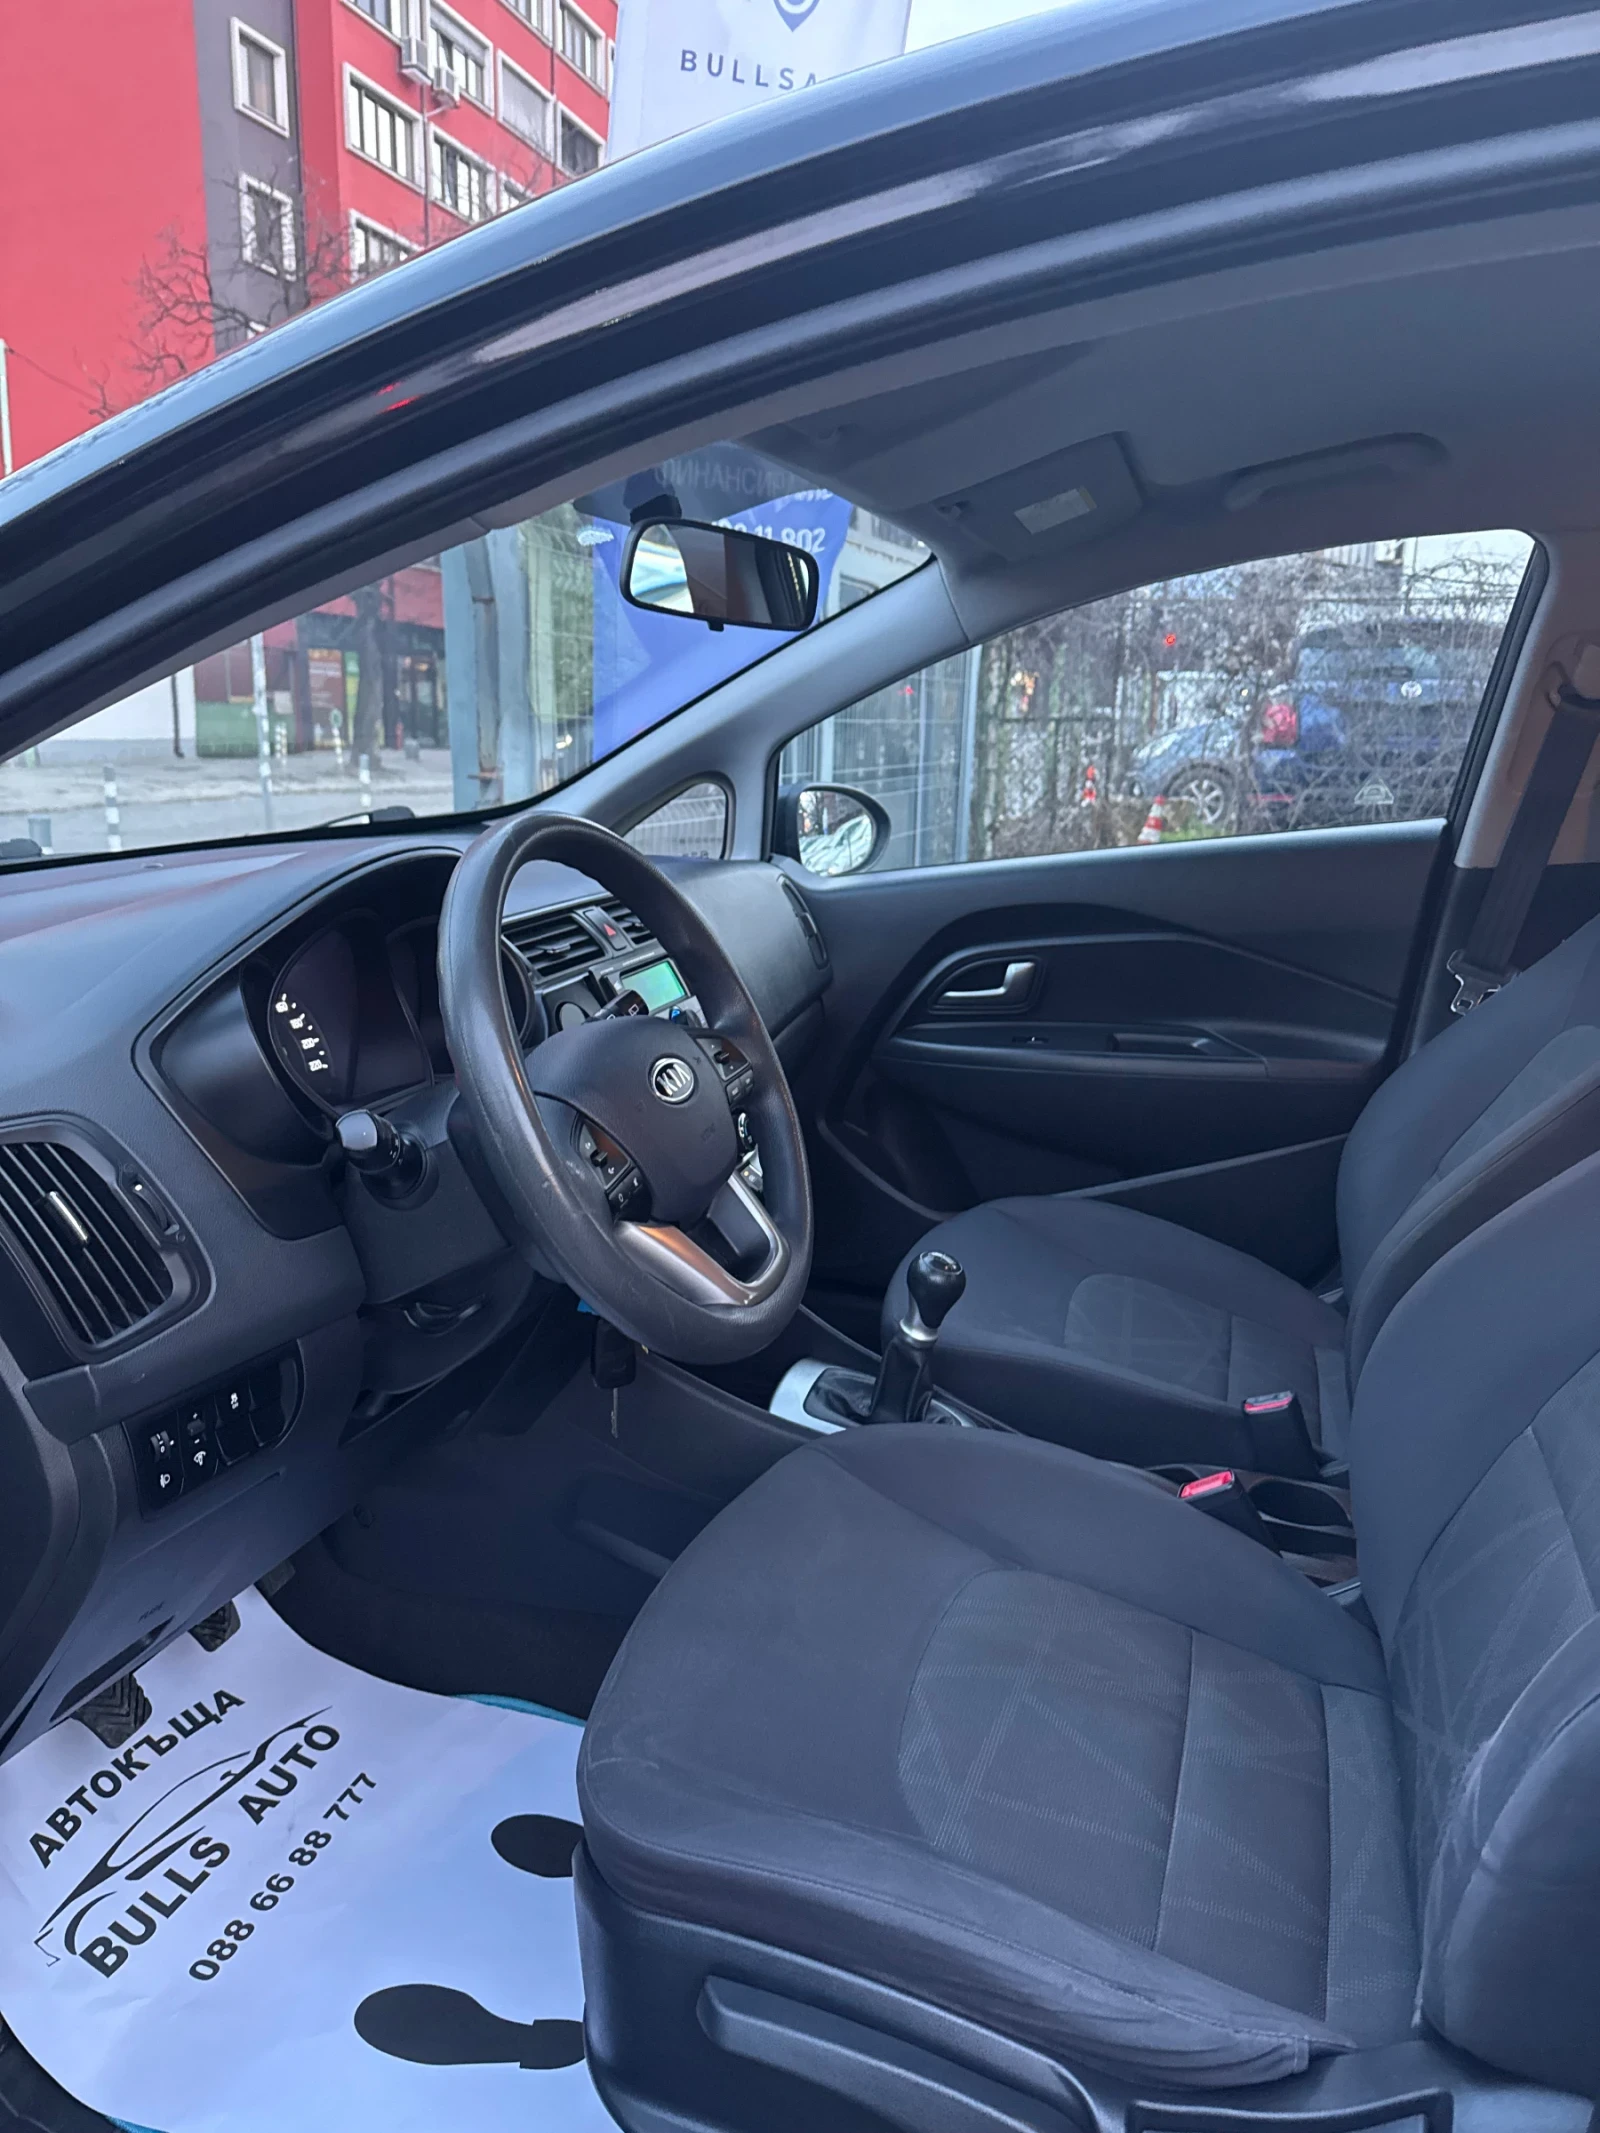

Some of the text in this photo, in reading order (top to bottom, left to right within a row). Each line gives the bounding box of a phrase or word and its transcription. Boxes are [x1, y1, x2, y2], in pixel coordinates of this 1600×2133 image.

[781, 527, 826, 554] 802
[656, 1063, 691, 1097] KIA
[29, 1688, 246, 1869] АВТОКЪЩА
[78, 1724, 340, 1978] BULLS AUTO
[188, 1772, 377, 1981] 088 66 88 777
